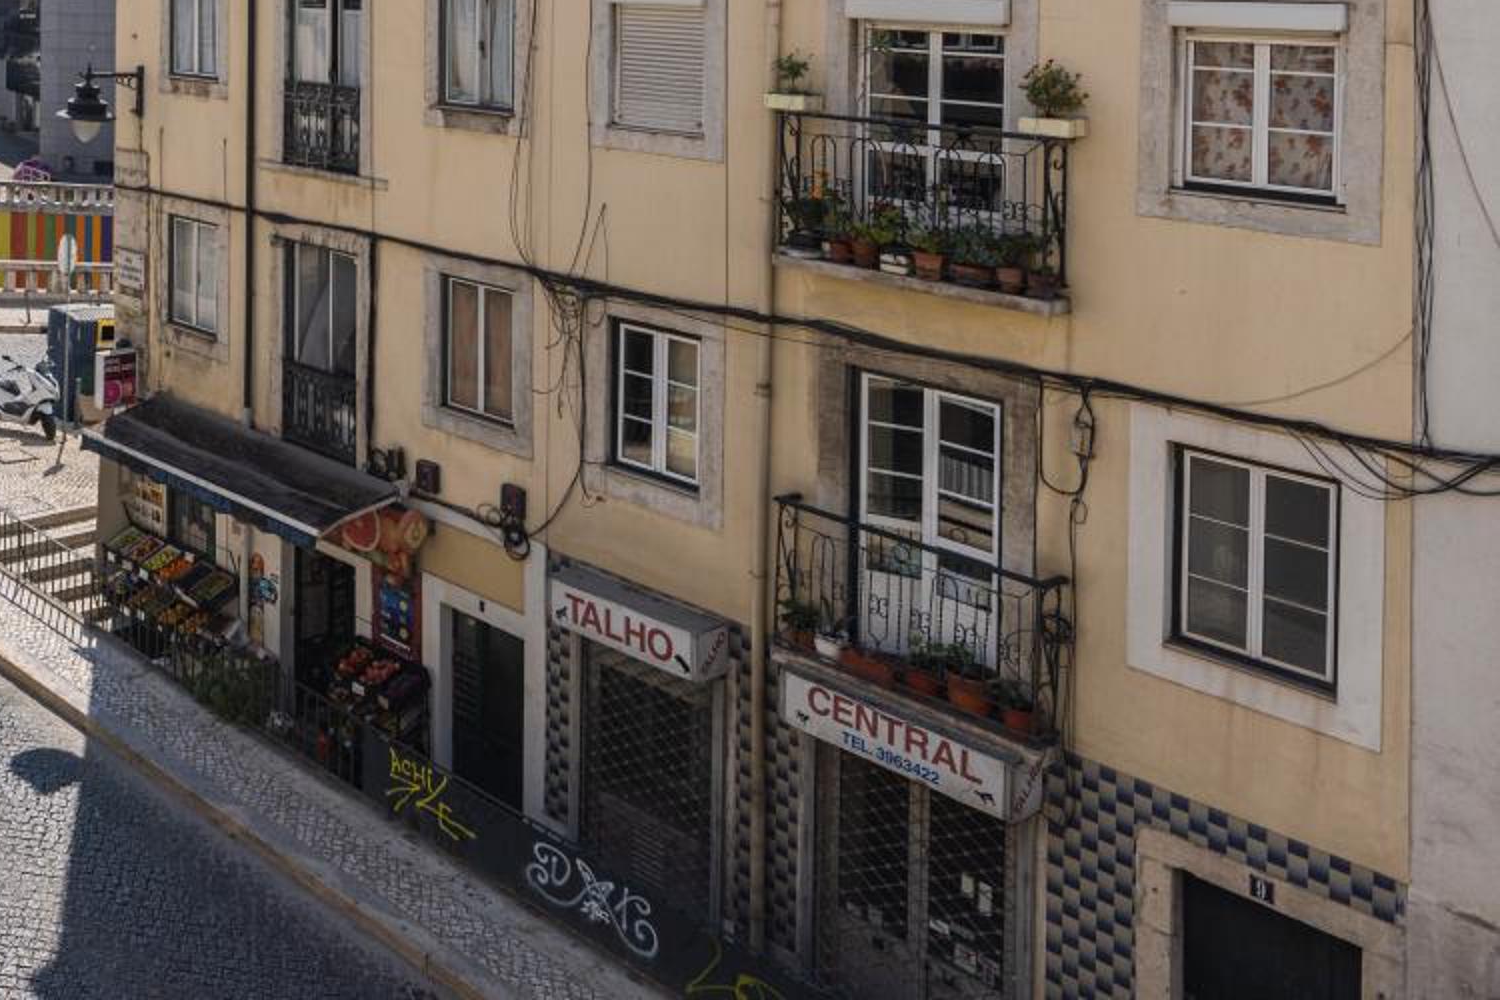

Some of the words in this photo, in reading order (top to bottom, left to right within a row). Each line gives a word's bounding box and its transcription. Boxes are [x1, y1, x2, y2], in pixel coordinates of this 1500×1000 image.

[565, 592, 673, 661] TALHO
[807, 686, 982, 785] CENTRAL
[842, 731, 873, 755] TEL.
